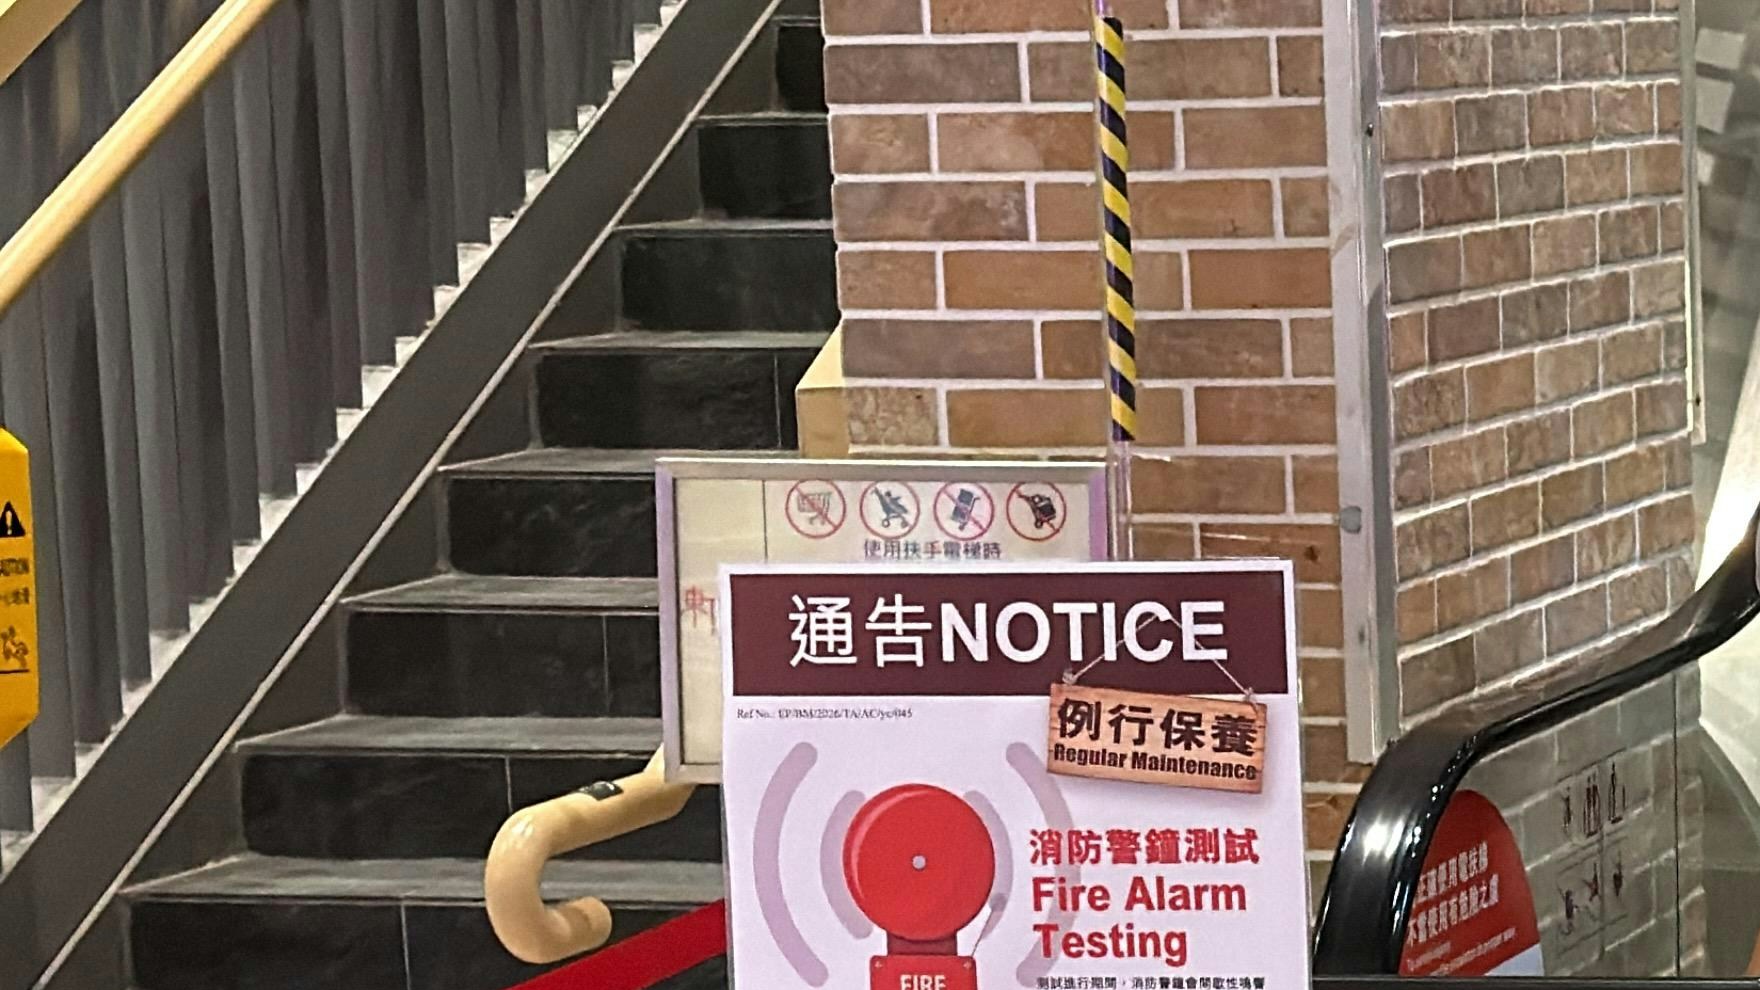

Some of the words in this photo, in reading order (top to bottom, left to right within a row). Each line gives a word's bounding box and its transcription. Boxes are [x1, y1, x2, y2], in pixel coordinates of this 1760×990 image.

[788, 593, 933, 668] 通告
[941, 601, 1228, 663] NOTICE
[1057, 698, 1259, 758] 例行保養
[1052, 743, 1128, 770] Regular
[1132, 749, 1258, 781] Maintenance
[1029, 828, 1260, 866] 消防警鐘測試
[1032, 876, 1111, 911] Fire
[1125, 876, 1247, 912] Alarm
[1033, 923, 1188, 966] Testing
